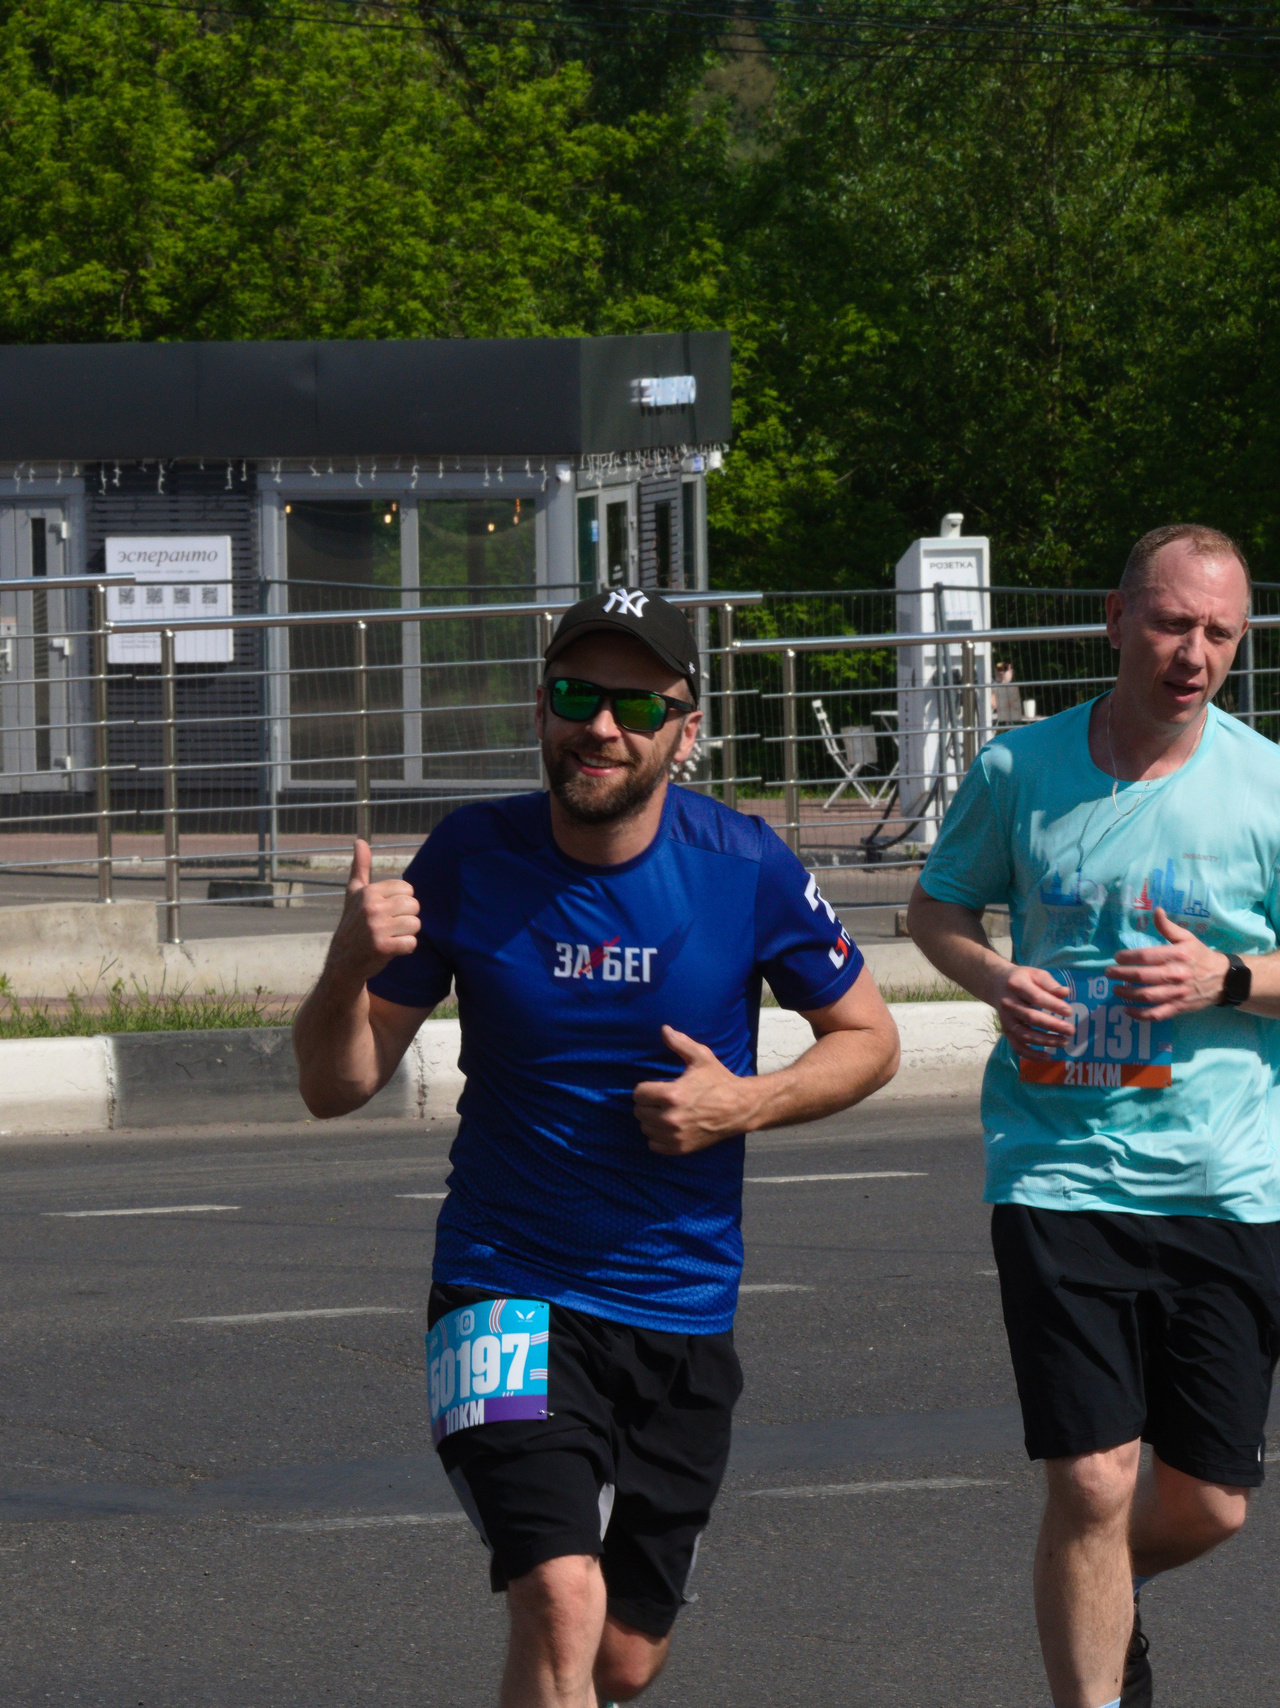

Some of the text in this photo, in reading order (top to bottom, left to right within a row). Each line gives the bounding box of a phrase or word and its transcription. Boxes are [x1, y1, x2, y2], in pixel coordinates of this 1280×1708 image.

[118, 549, 219, 567] эсперанто
[929, 561, 974, 570] РОЗЕТКА
[603, 588, 650, 618] NY
[430, 1332, 530, 1417] 50197
